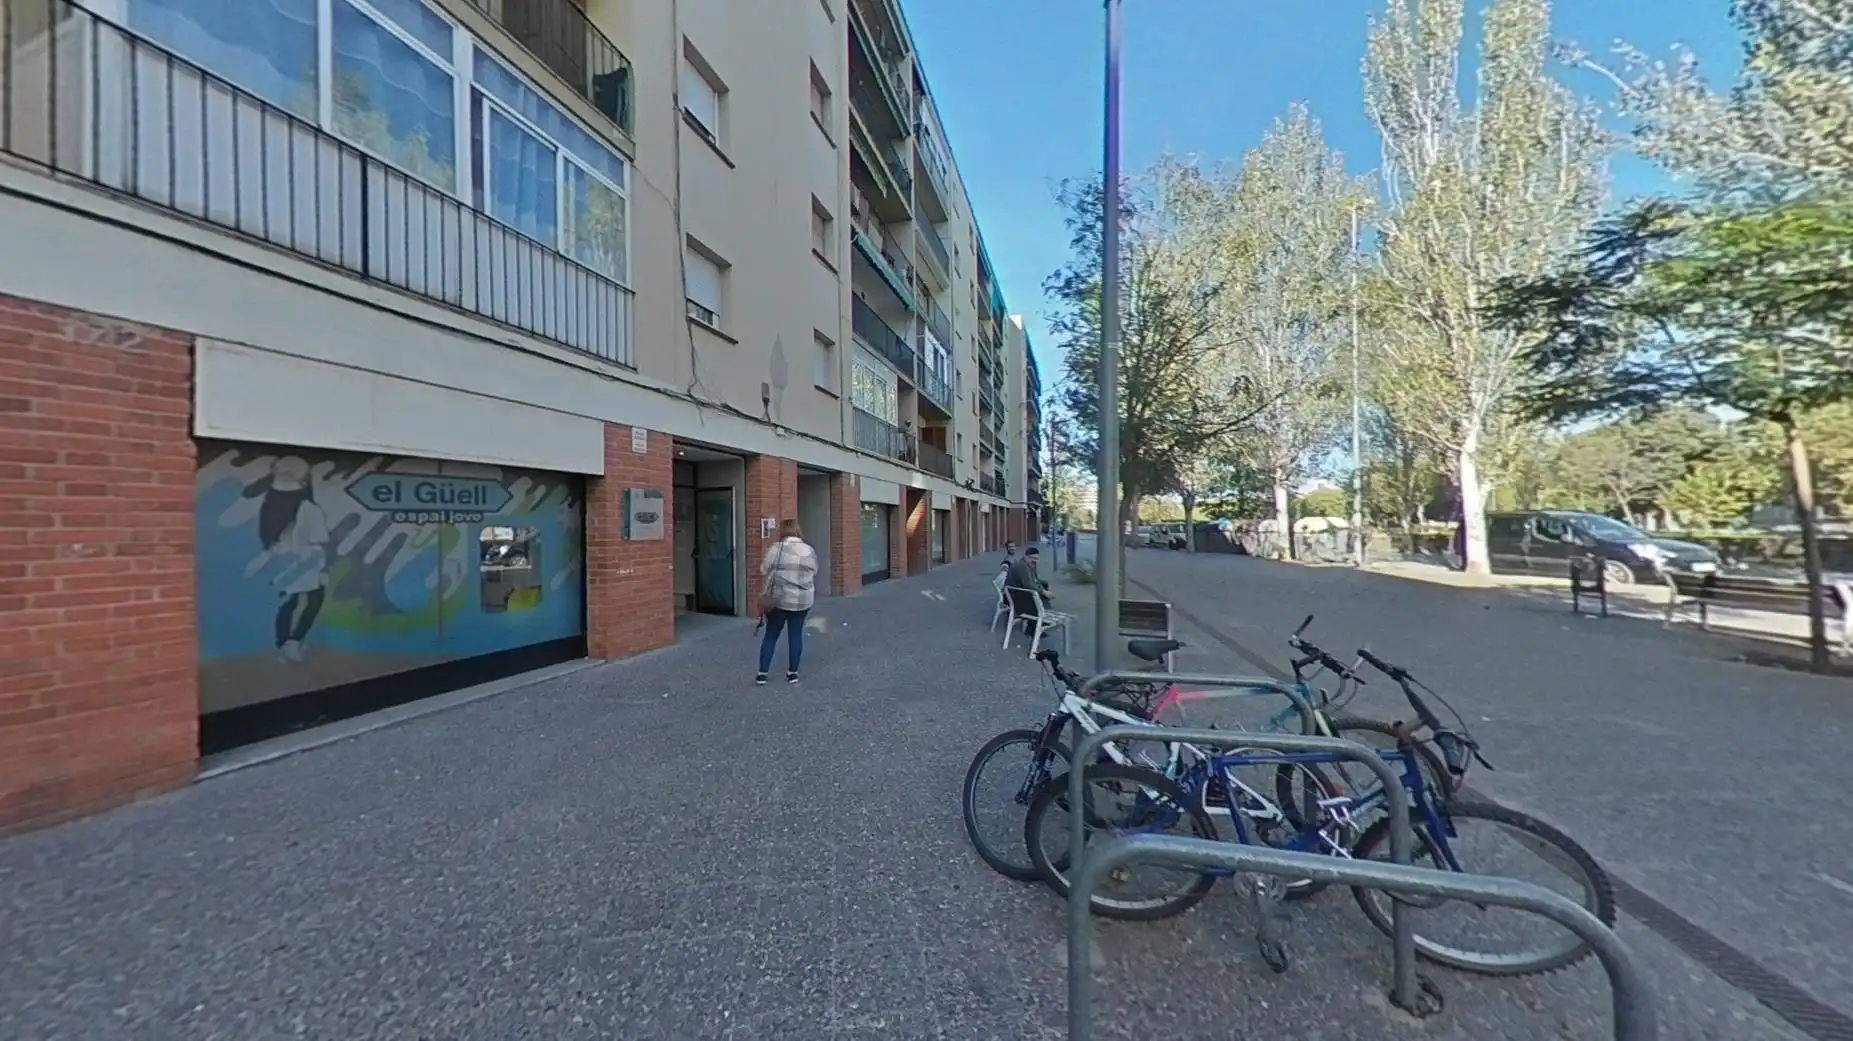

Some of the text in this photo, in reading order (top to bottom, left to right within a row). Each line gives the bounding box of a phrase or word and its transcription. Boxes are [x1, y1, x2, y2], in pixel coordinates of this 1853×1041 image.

[372, 480, 487, 505] el Güell
[394, 511, 445, 525] espai
